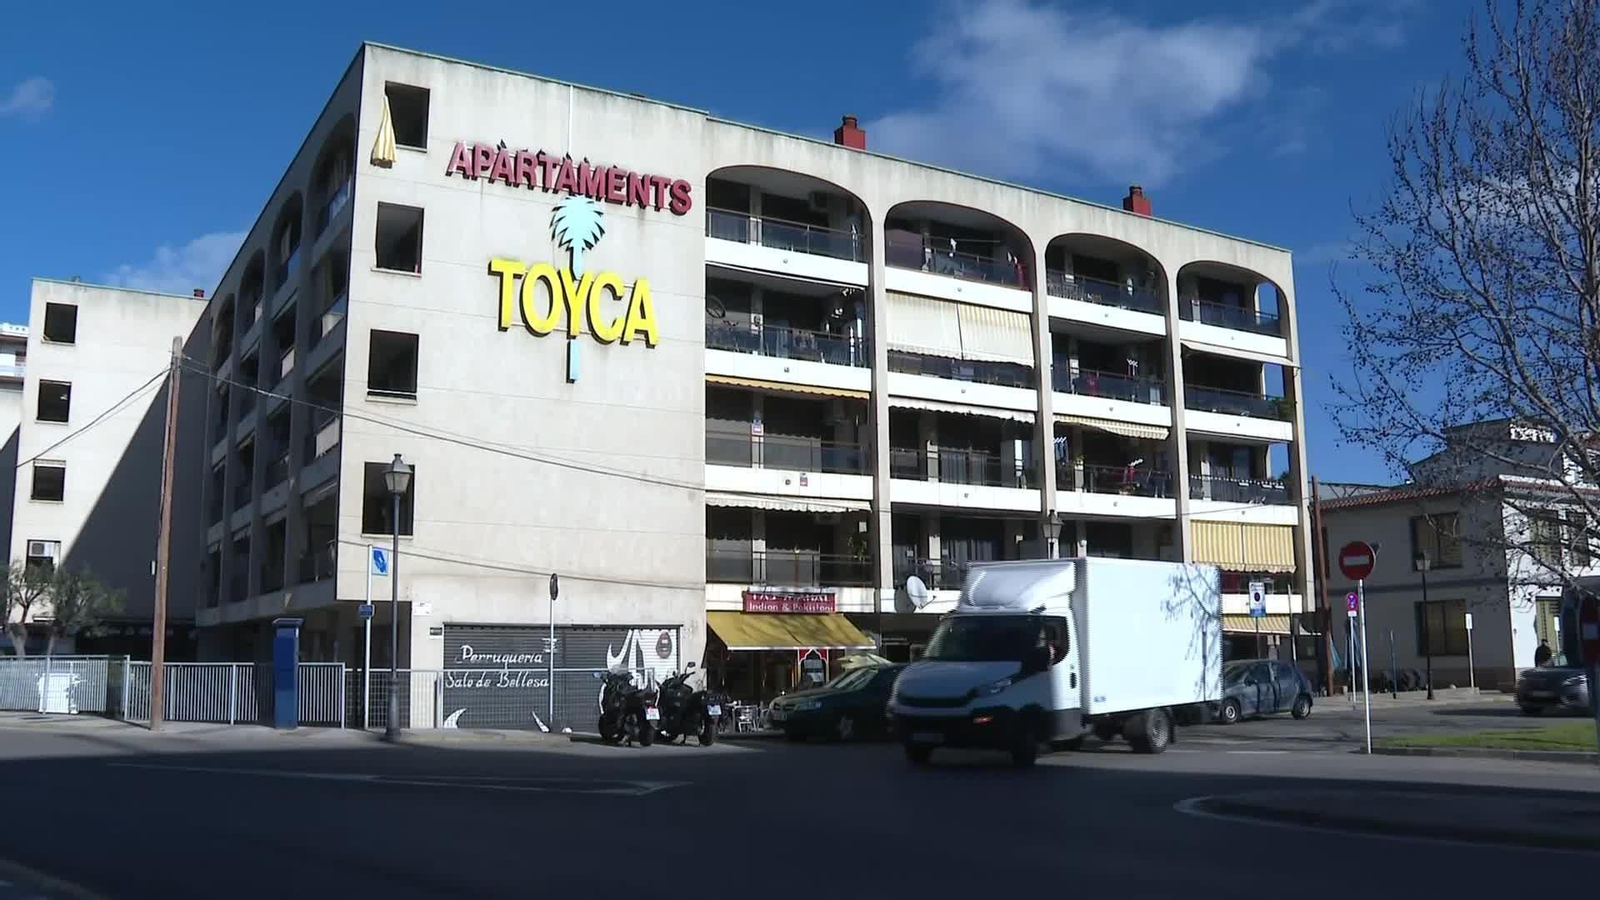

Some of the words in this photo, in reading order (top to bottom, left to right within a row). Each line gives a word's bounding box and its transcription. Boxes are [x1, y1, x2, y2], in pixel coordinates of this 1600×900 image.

[446, 140, 692, 215] APARTAMENTS
[488, 258, 659, 348] TOYCA
[782, 603, 789, 611] &
[475, 671, 491, 688] de
[496, 671, 549, 688] Bellesa
